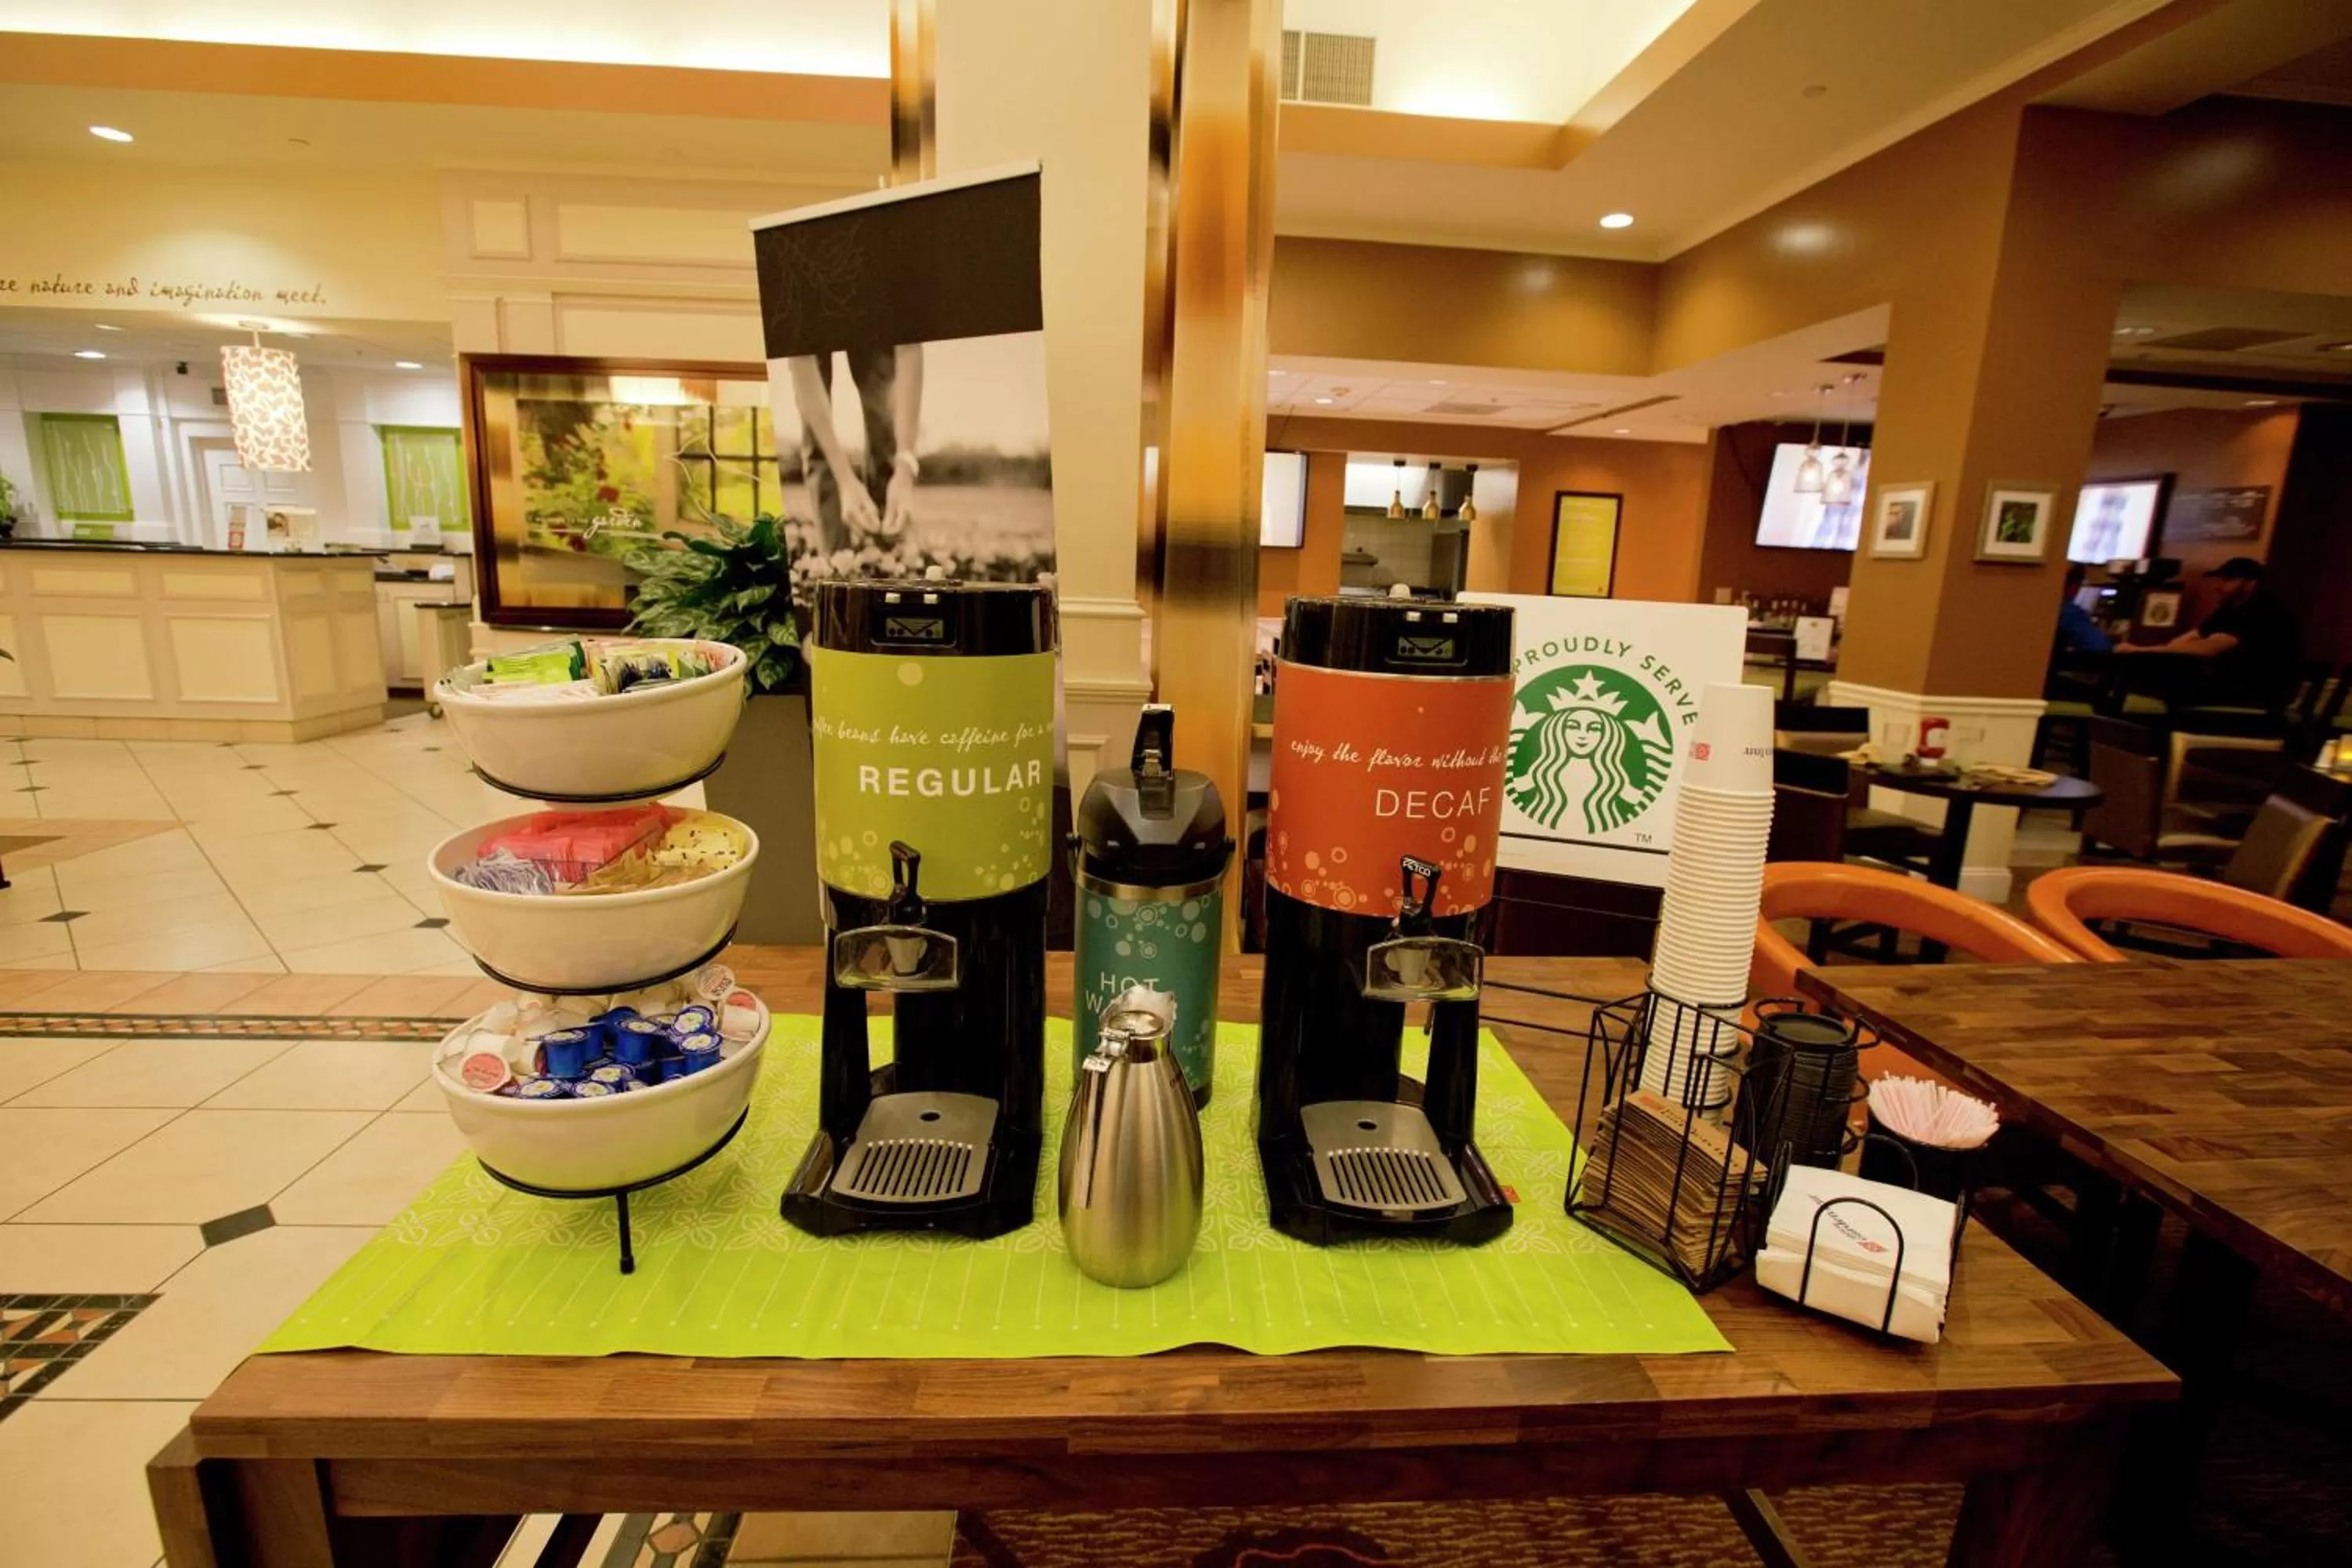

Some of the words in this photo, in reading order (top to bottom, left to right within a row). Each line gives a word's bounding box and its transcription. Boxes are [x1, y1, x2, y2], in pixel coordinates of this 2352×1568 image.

[31, 273, 95, 295] nature
[104, 277, 140, 298] and
[150, 280, 264, 307] imagination
[1639, 655, 1699, 727] SERVE
[889, 724, 931, 745] have
[940, 726, 1010, 753] caffeine
[1291, 739, 1324, 764] enjoy
[1333, 742, 1361, 763] the
[1367, 747, 1425, 773] flavor
[1432, 747, 1487, 769] without
[858, 758, 1041, 798] REGULAR
[1375, 786, 1492, 819] DECAF
